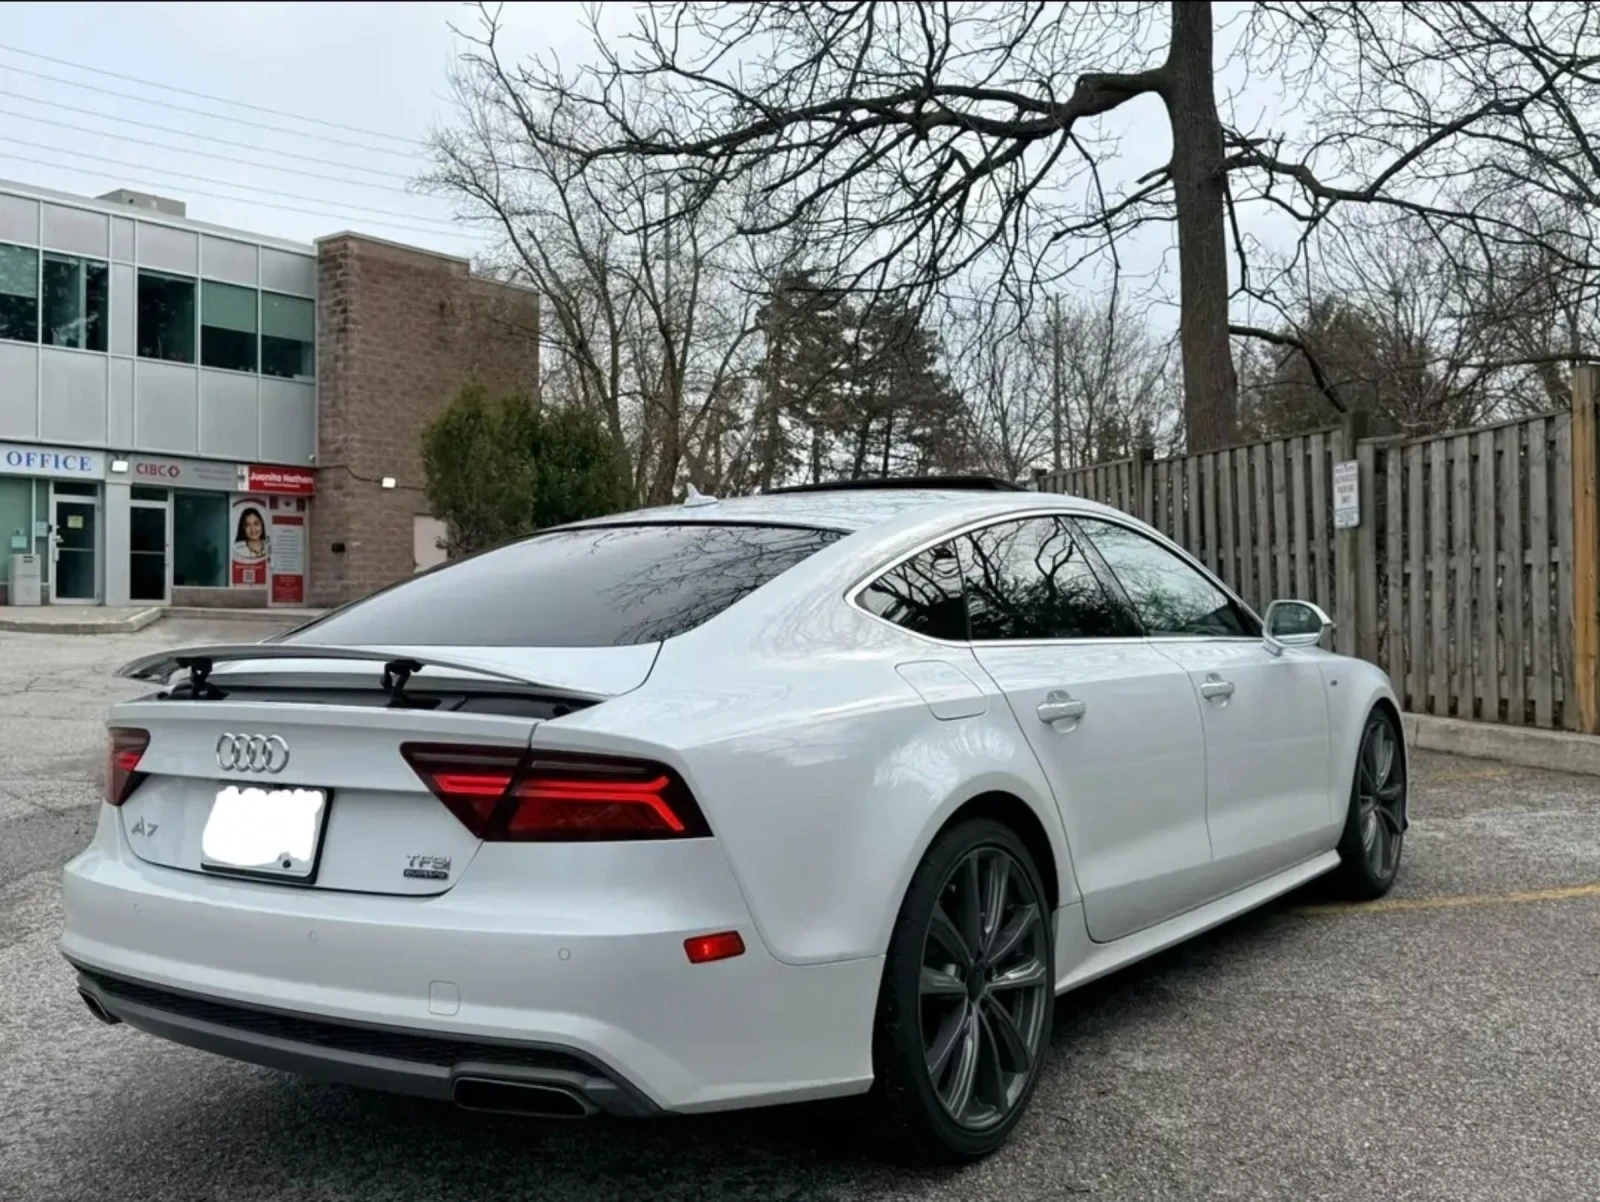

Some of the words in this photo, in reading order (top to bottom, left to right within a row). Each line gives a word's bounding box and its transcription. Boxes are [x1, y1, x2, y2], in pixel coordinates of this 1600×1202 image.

[6, 450, 92, 472] OFFICE
[135, 462, 166, 477] CIBC
[131, 815, 158, 837] A7
